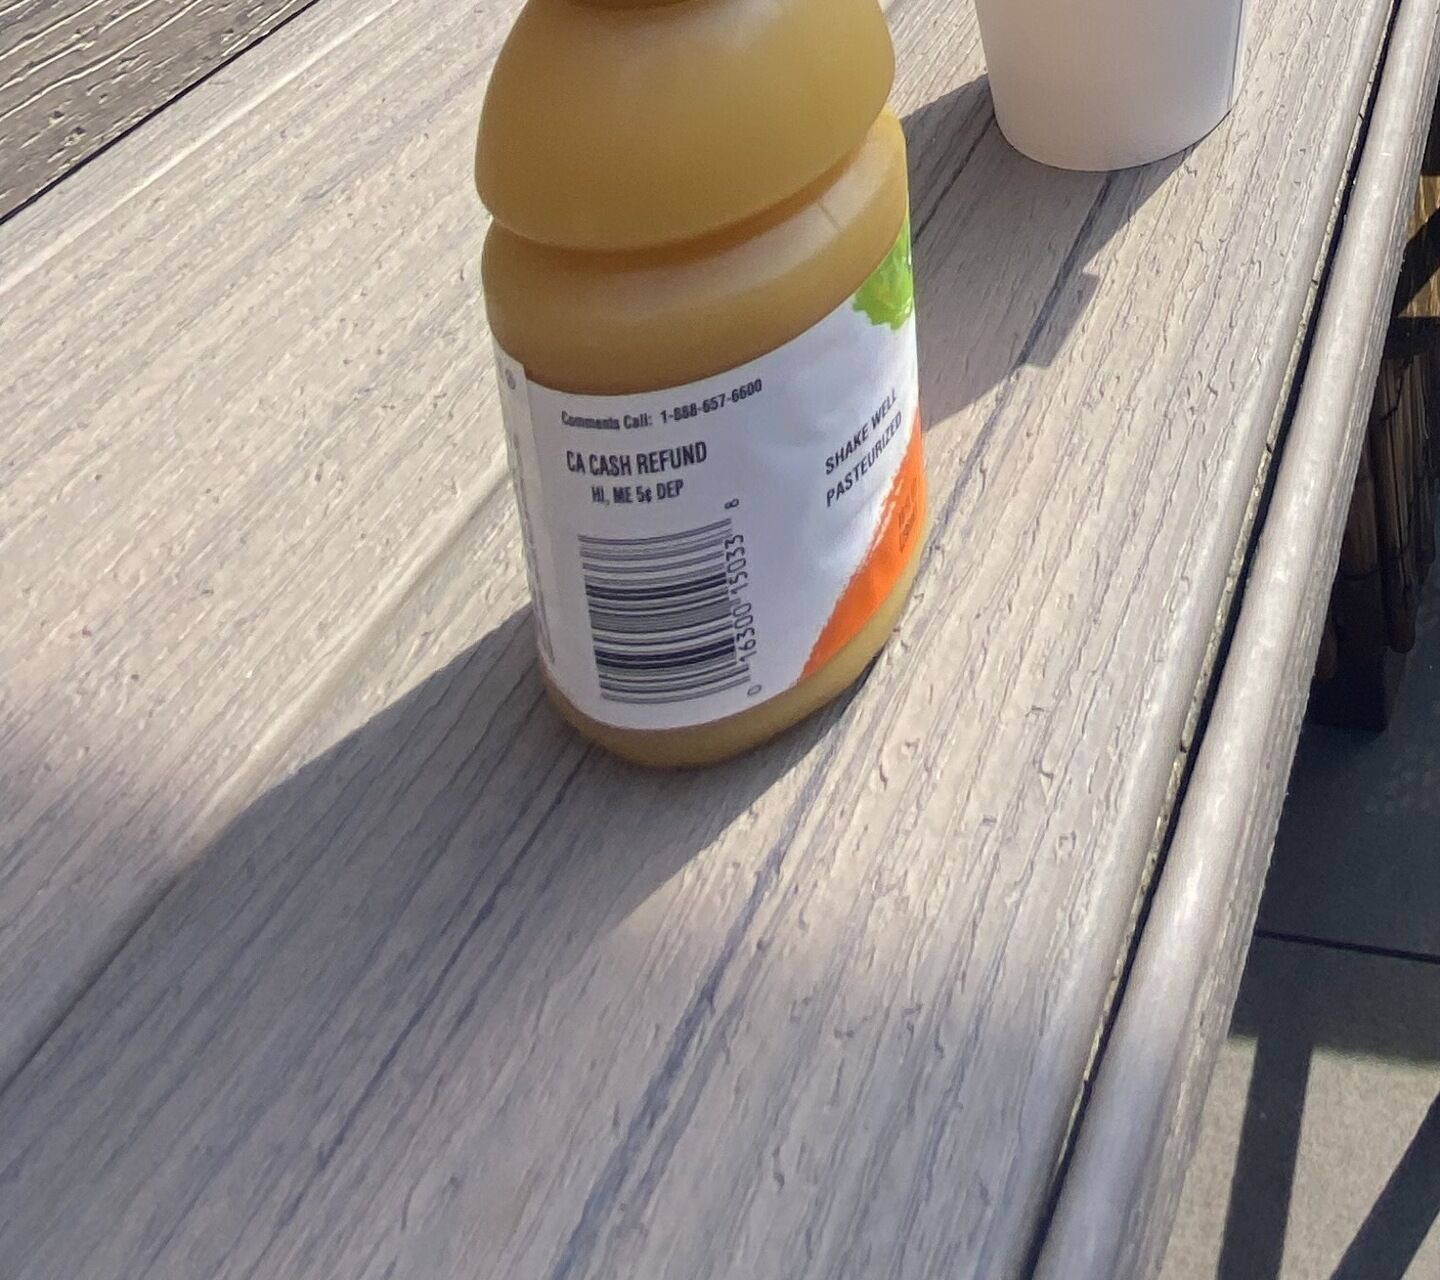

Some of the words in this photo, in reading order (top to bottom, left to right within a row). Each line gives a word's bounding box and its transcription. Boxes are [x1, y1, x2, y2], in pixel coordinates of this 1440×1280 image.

[561, 410, 620, 430] Comments
[623, 413, 653, 429] Call:
[660, 378, 763, 424] 1-888-657-6600
[825, 423, 870, 475] SHAKE
[871, 387, 897, 430] WELL
[566, 450, 586, 474] CA
[589, 453, 633, 476] CASH
[636, 441, 708, 475] REFUND
[826, 411, 902, 508] PASTEURIZED
[591, 486, 610, 506] HI,
[613, 486, 634, 504] ME
[636, 486, 653, 504] 5¢
[656, 479, 684, 500] DEP
[724, 498, 740, 510] 8
[724, 533, 749, 595] 15033
[733, 602, 758, 662] 16300
